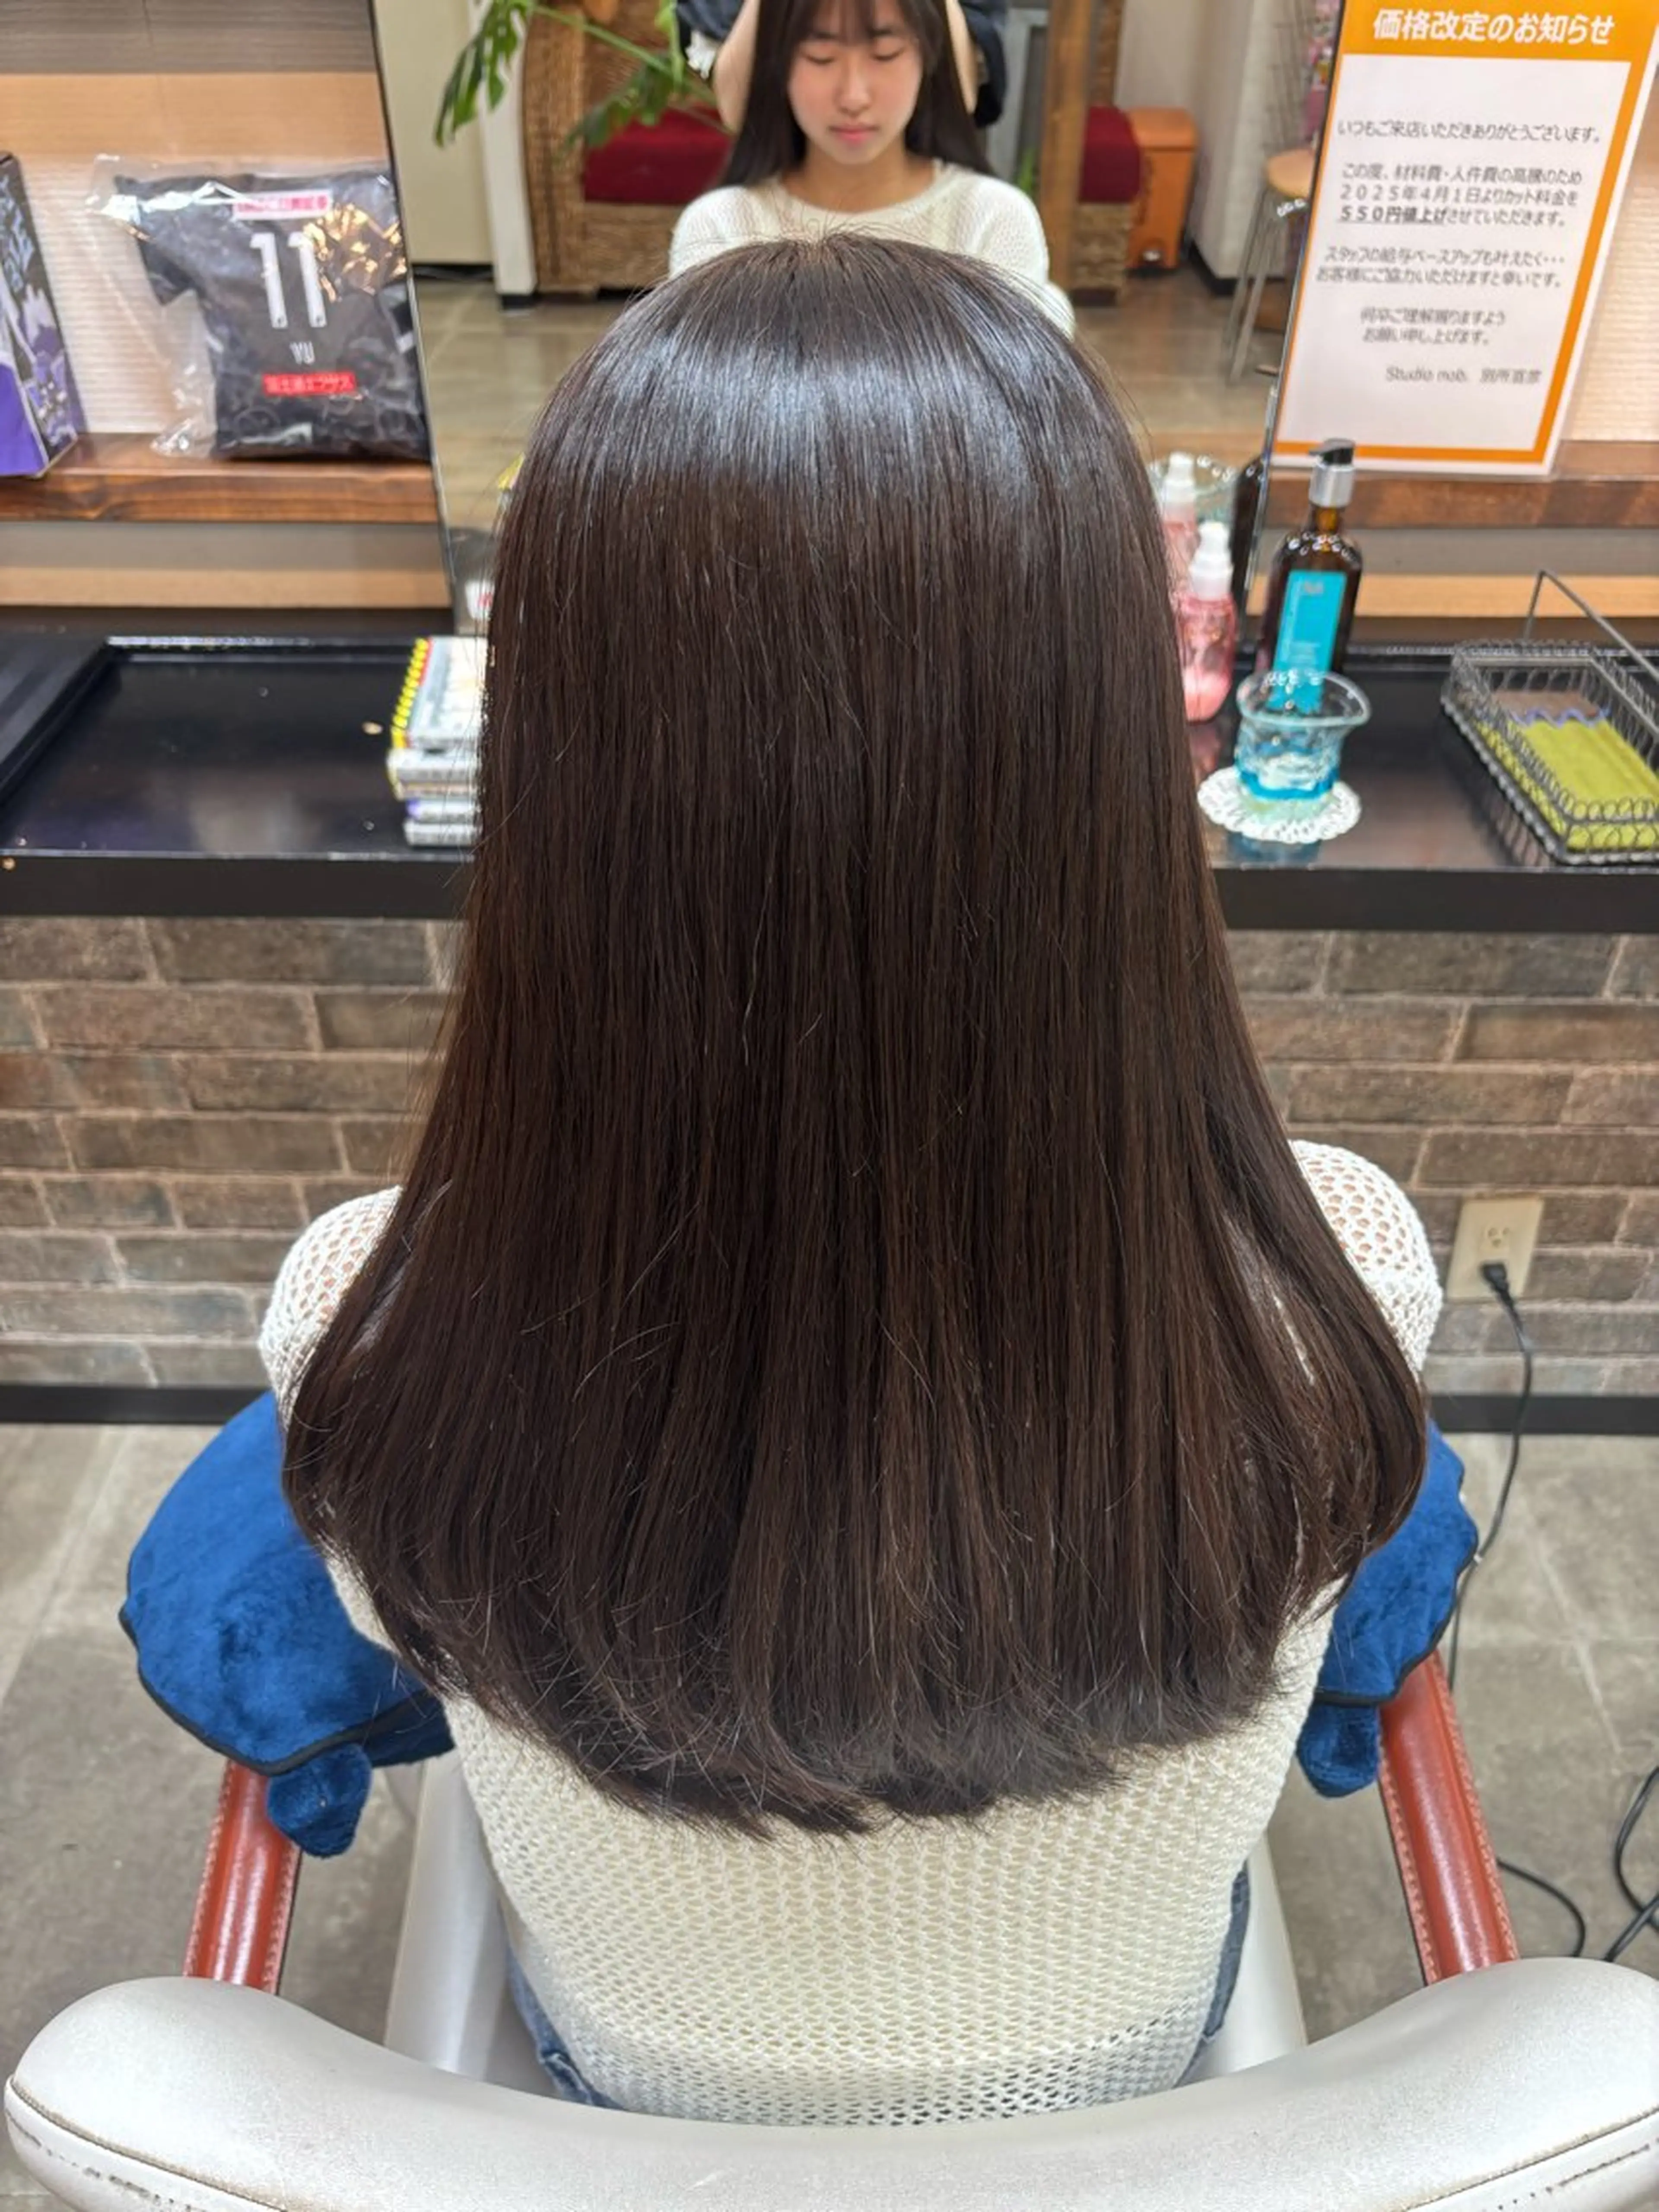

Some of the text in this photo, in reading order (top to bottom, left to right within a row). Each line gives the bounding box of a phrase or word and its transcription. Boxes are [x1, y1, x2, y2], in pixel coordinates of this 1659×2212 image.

[1373, 9, 1615, 44] 価格改定のお知らせ
[249, 232, 327, 329] 11
